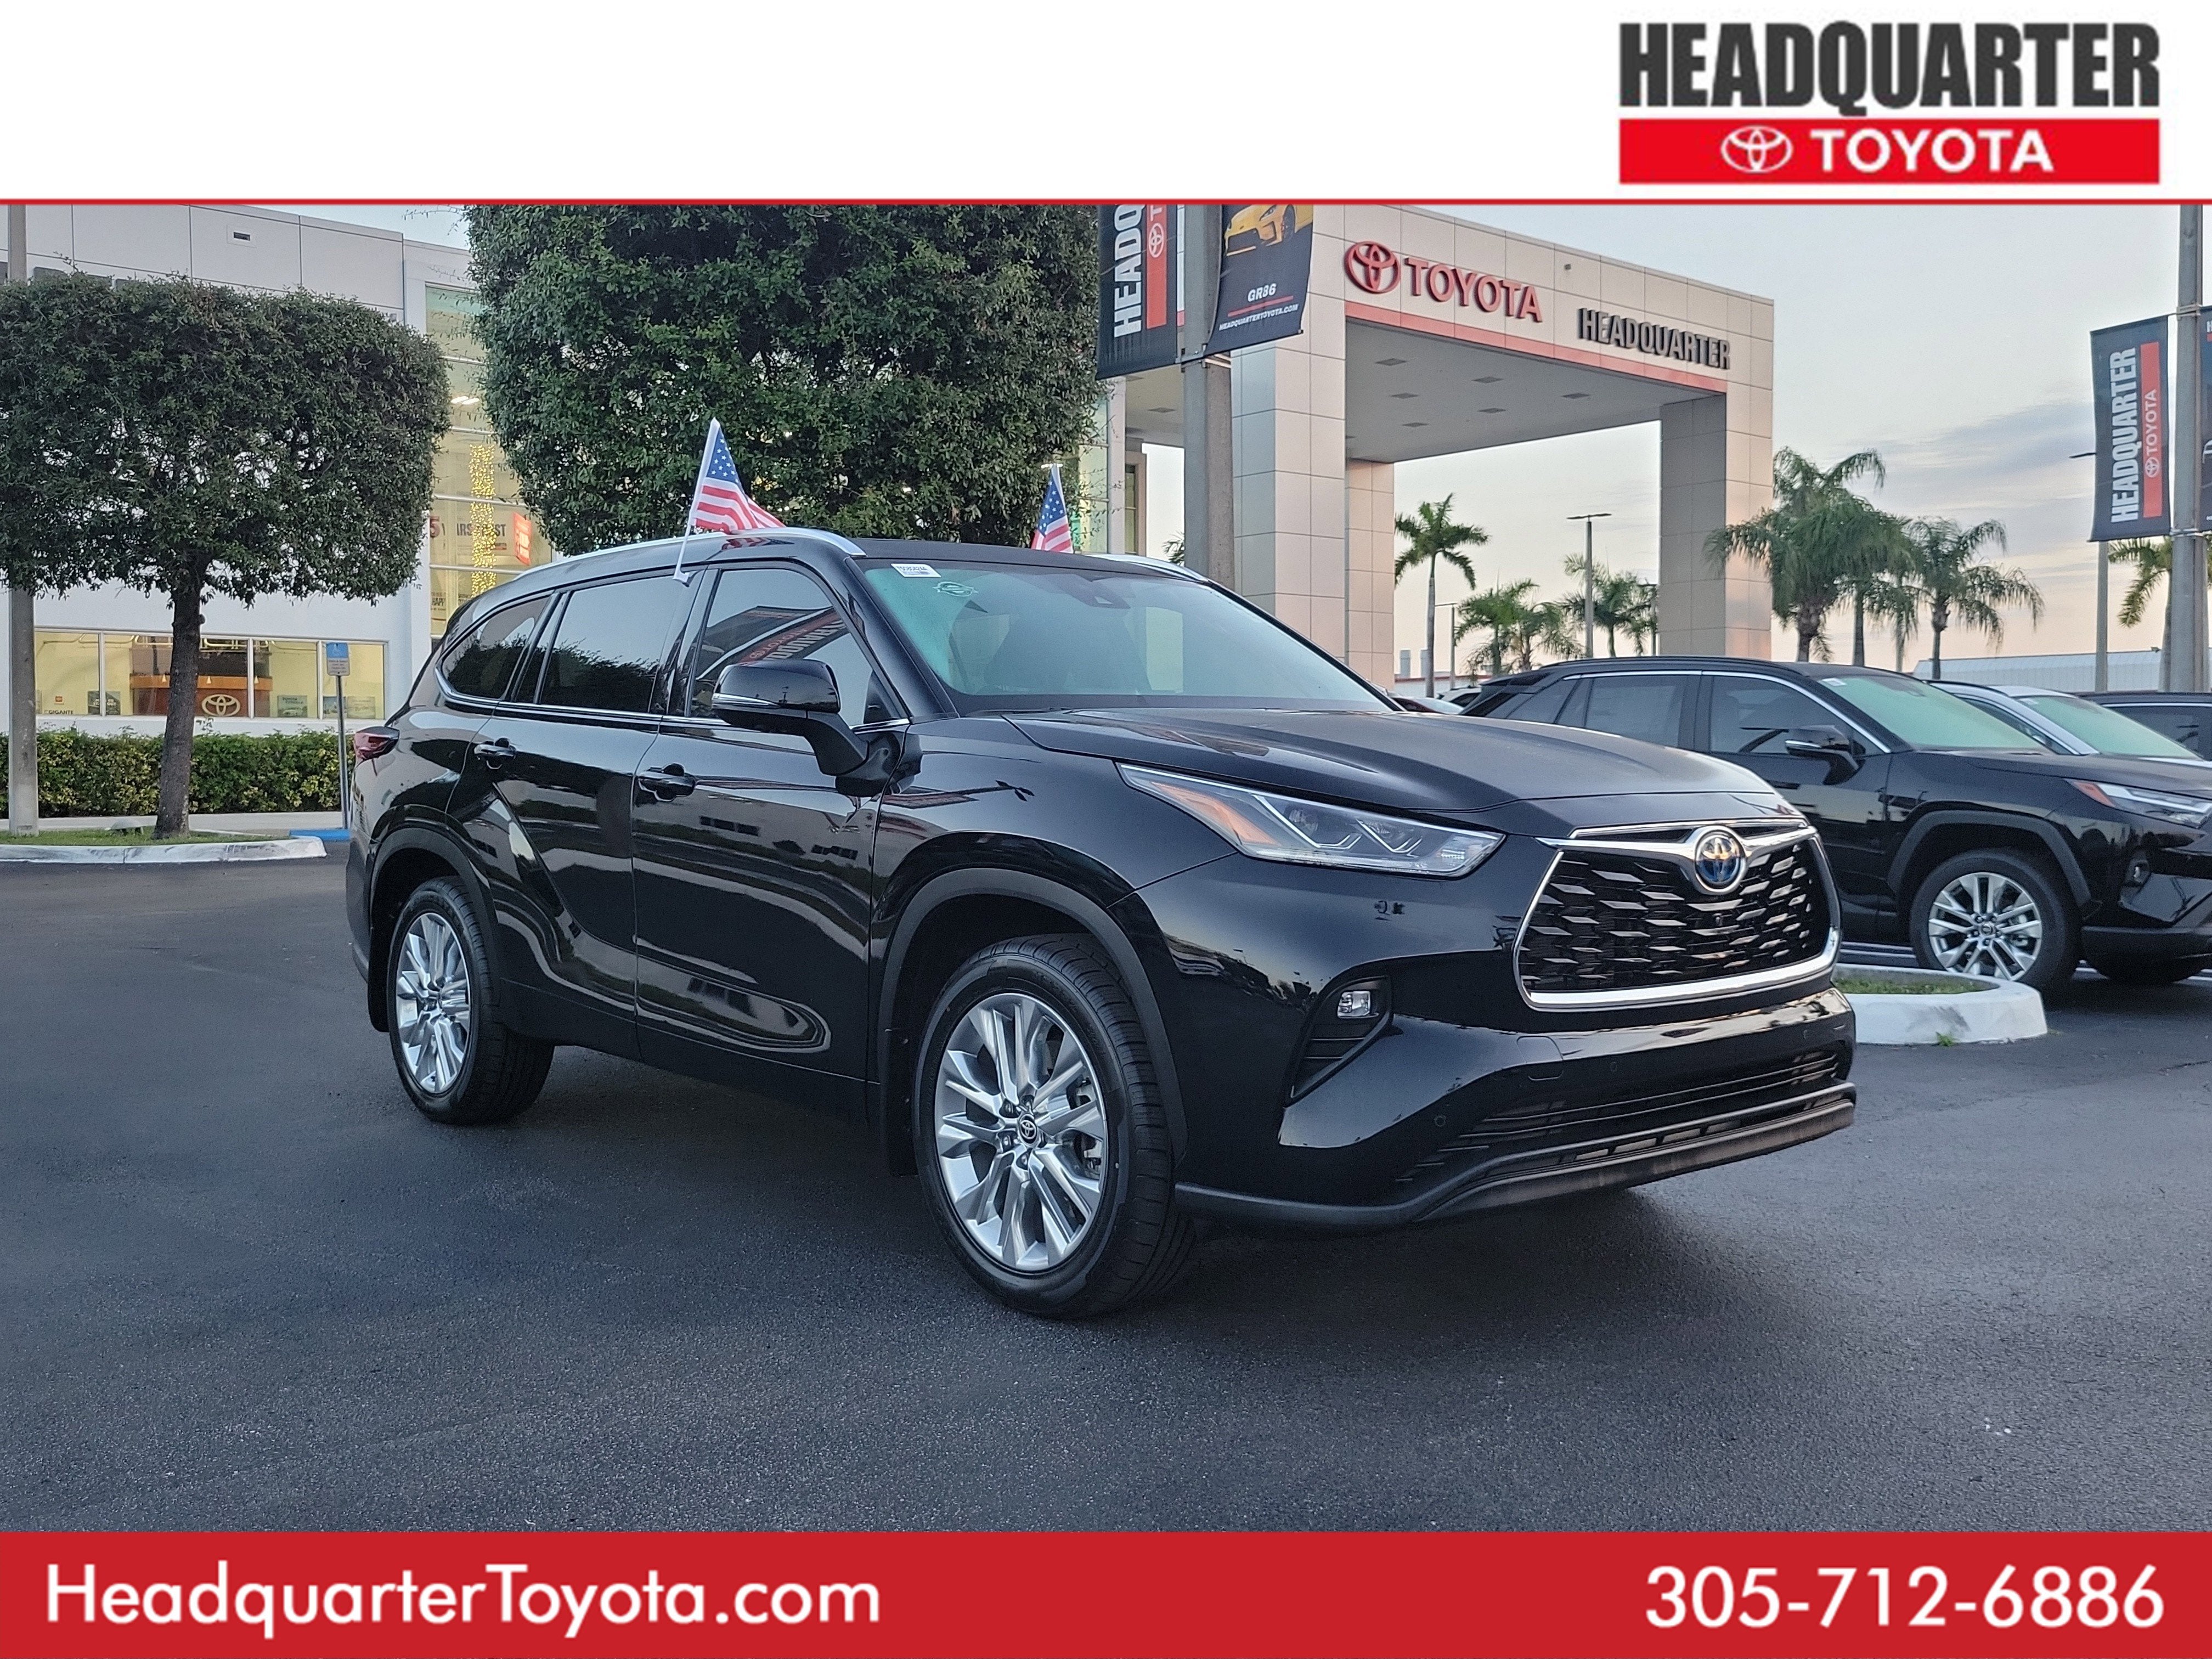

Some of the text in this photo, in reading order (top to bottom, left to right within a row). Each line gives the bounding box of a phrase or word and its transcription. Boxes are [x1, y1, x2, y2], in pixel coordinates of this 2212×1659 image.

[1219, 303, 1299, 331] HEADQUARTERTOYOTA.COM
[1247, 283, 1277, 302] GR86
[1404, 257, 1543, 323] TOYOTA
[1577, 308, 1730, 370] HEADQUARTER
[2109, 347, 2142, 523] HEADQUARTER
[2145, 388, 2158, 456] TOYOTA
